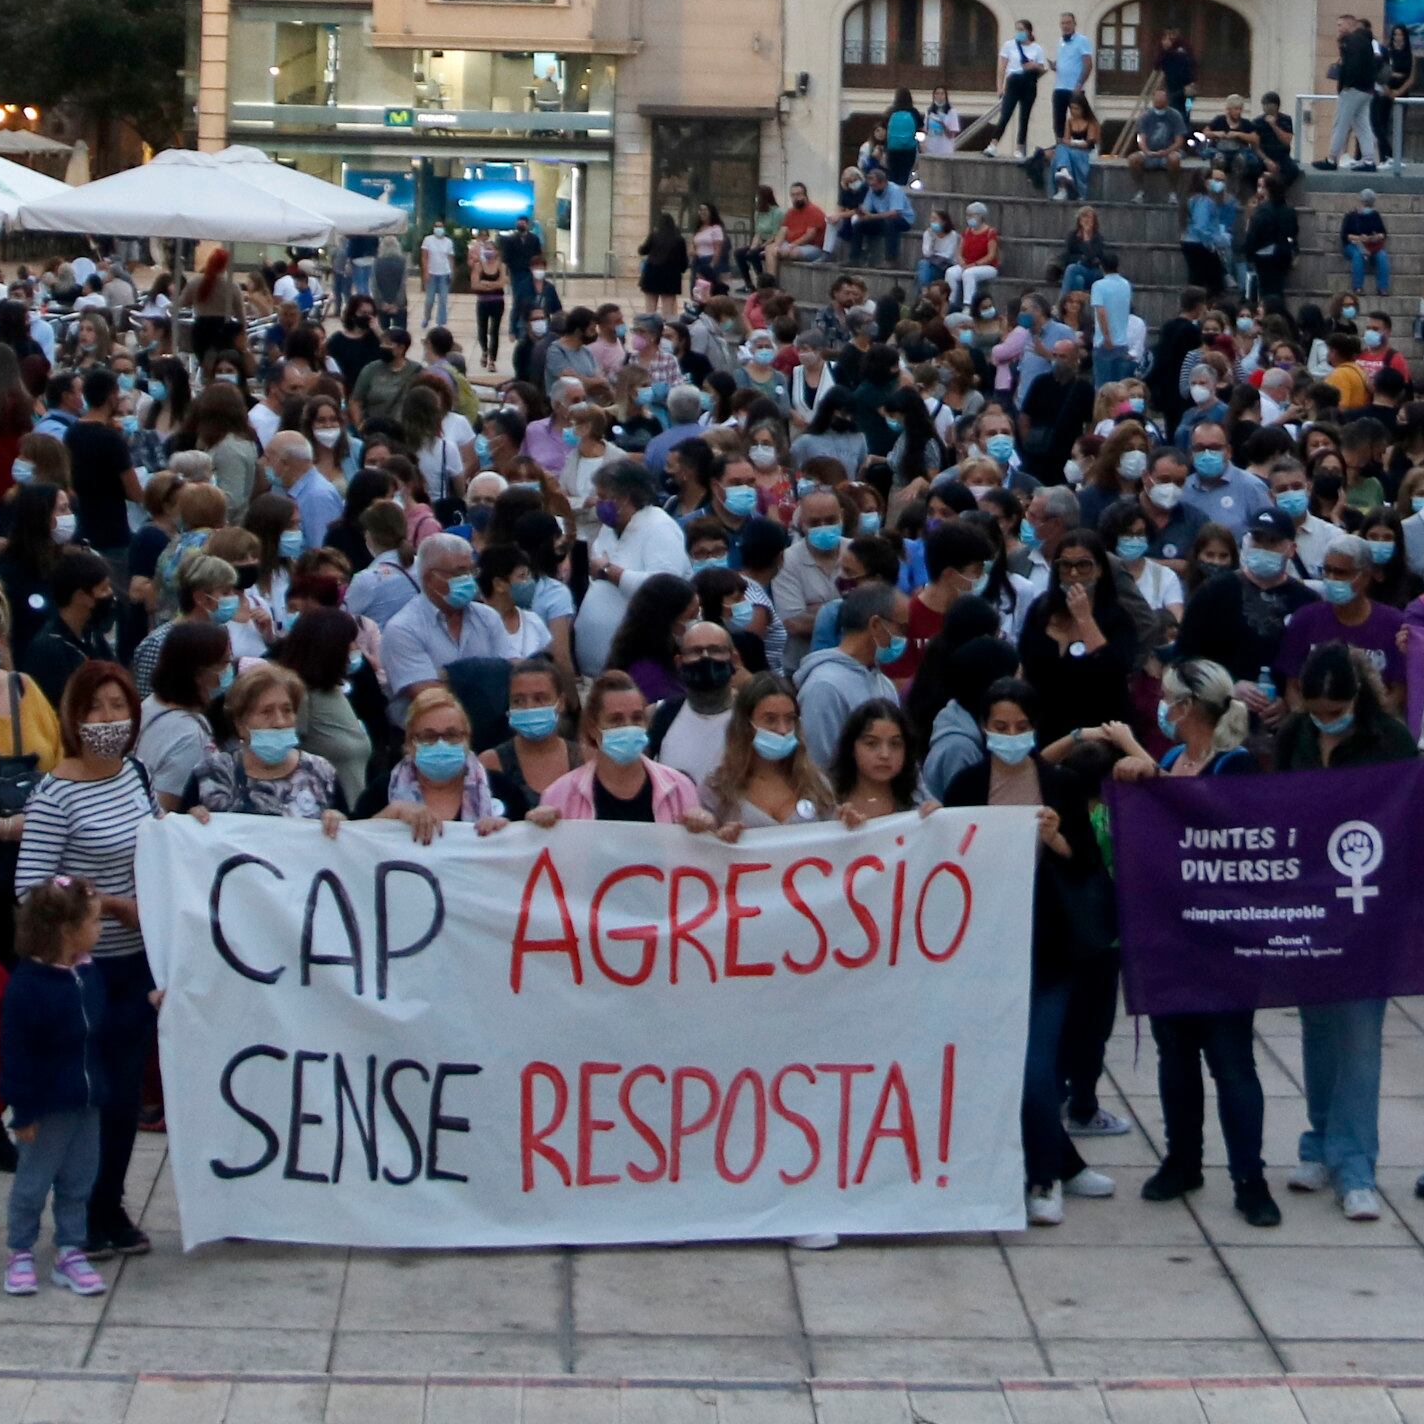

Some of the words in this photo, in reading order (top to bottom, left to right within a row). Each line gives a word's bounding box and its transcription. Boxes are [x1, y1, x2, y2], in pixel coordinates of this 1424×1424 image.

[1178, 826, 1276, 850] JUNTES
[1180, 857, 1301, 884] DIVERSES
[208, 852, 446, 1000] CAP
[509, 822, 979, 994] AGRESSIÓ
[1181, 904, 1327, 924] #imparablesdepoble
[208, 1042, 484, 1186] SENSE
[518, 1042, 957, 1194] RESPOSTA!
